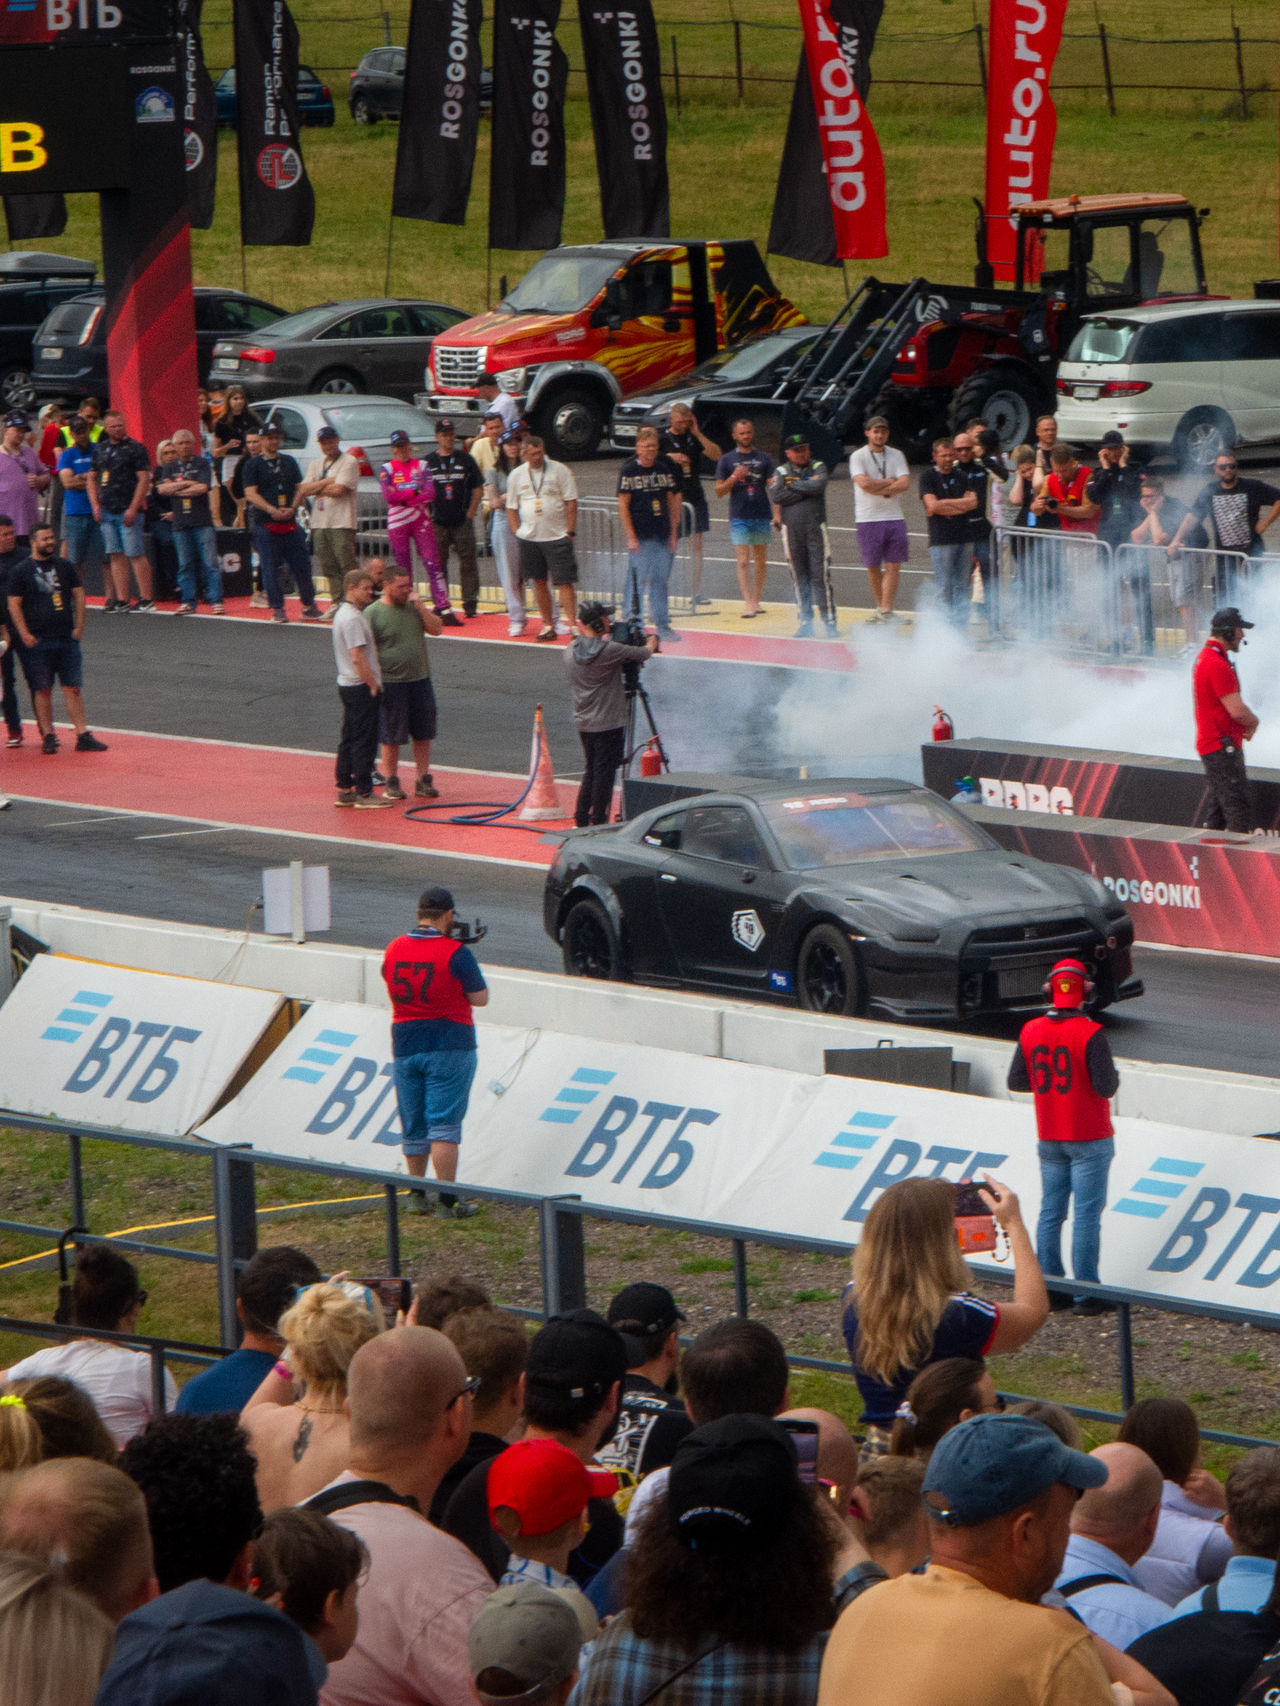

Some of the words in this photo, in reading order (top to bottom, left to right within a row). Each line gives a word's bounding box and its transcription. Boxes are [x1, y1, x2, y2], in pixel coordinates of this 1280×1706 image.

[439, 0, 469, 139] ROSGONK
[530, 20, 553, 166] ROSGONKI
[617, 11, 653, 160] ROSGONKI
[814, 0, 866, 211] auto.r
[393, 961, 435, 1004] 57
[62, 1016, 203, 1104] ВТБ
[1032, 1045, 1074, 1096] 69
[563, 1096, 722, 1190] ВТБ
